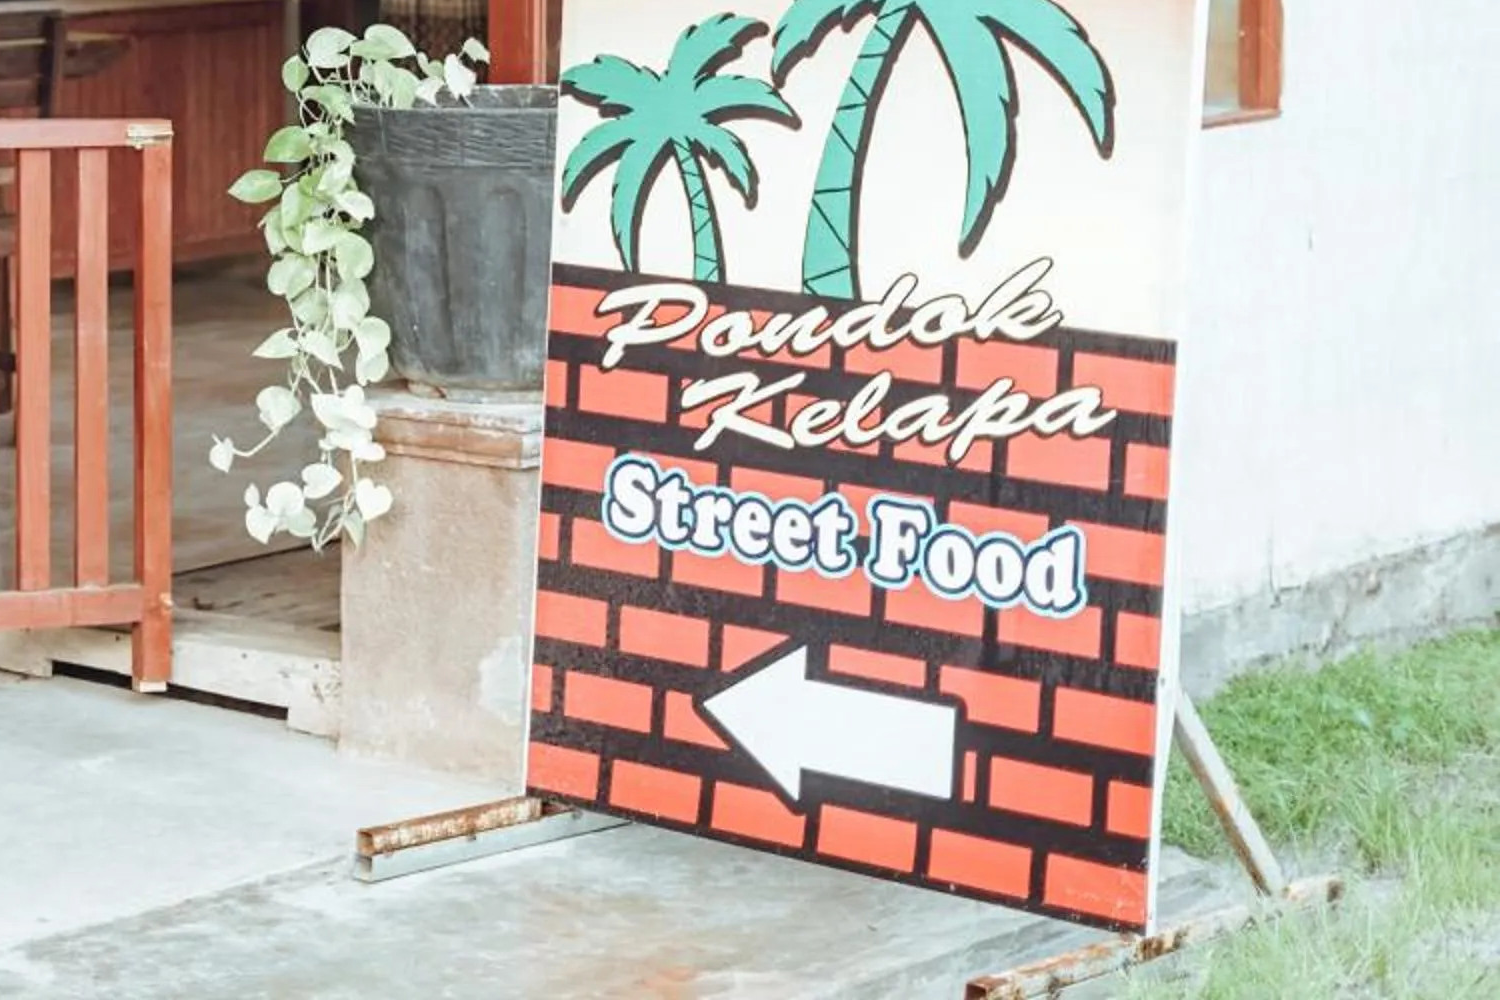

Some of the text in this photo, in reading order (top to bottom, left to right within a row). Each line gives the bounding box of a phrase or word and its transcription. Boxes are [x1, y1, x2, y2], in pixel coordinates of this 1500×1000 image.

[597, 256, 1064, 370] Pondok
[680, 370, 1118, 465] Kelapa
[603, 456, 1084, 615] Street Food
